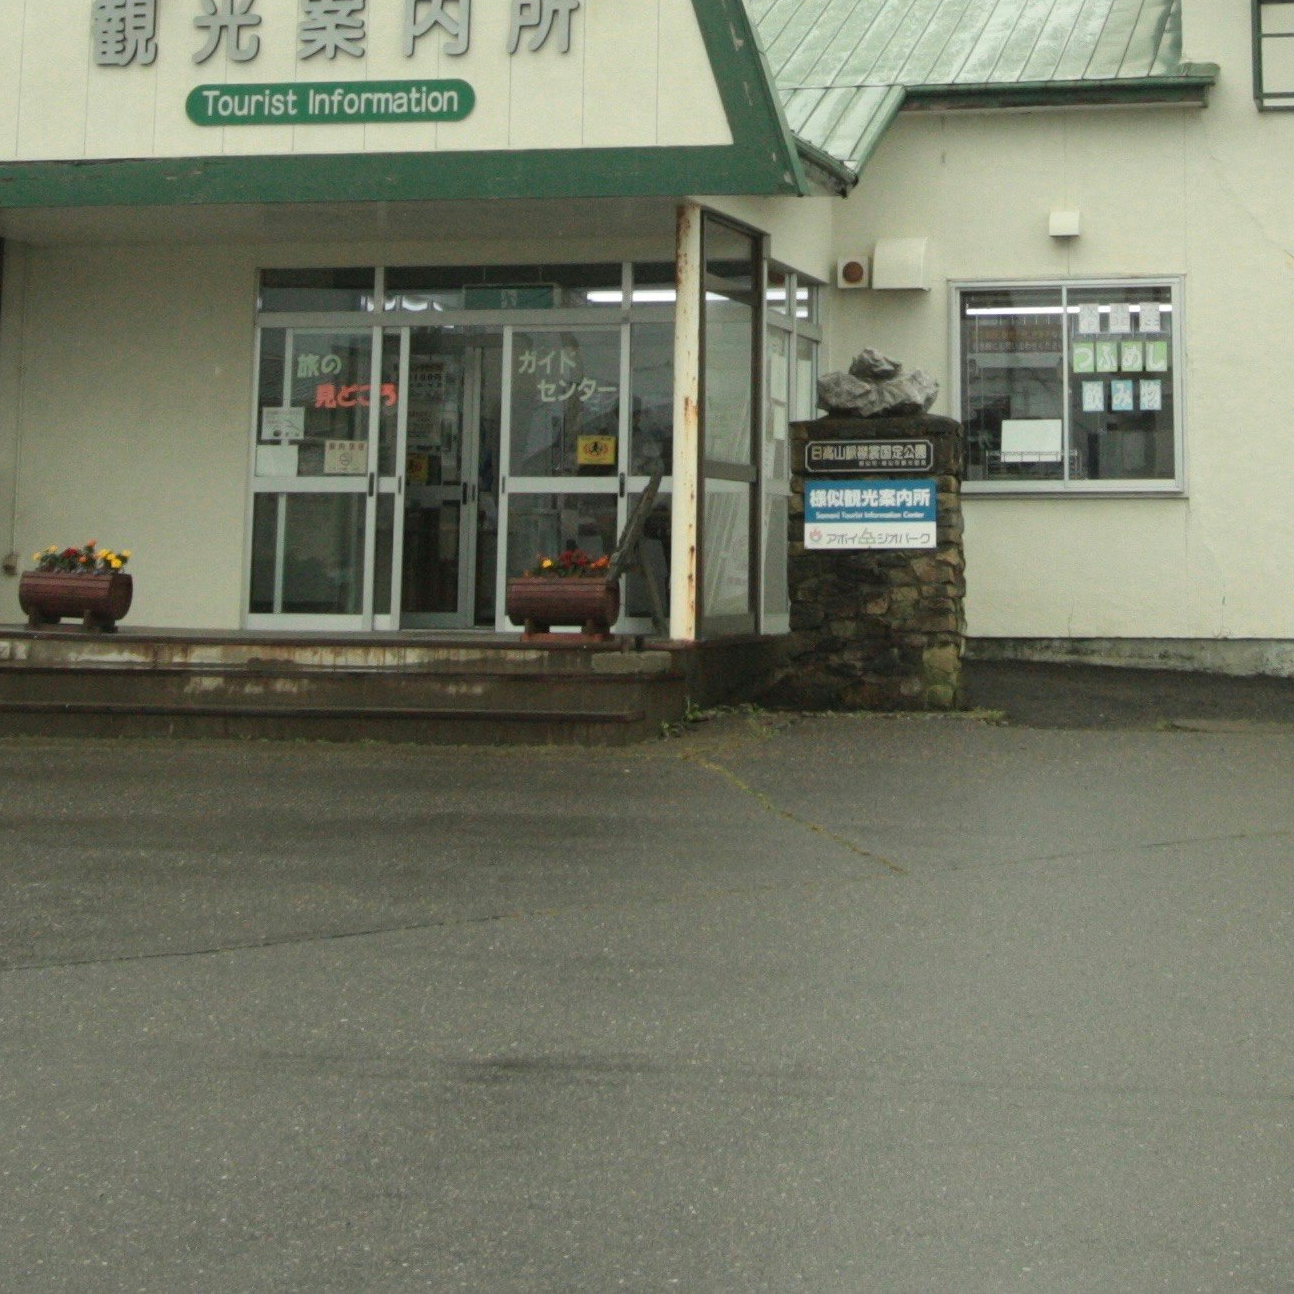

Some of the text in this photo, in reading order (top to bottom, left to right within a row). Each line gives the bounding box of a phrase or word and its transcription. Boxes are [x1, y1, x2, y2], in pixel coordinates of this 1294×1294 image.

[203, 87, 459, 118] Tourist Information
[297, 354, 342, 378] 旅の
[518, 349, 577, 374] ガイド
[314, 382, 398, 408] 見どころ
[537, 377, 618, 402] センター
[809, 488, 931, 507] 様似観光案内所
